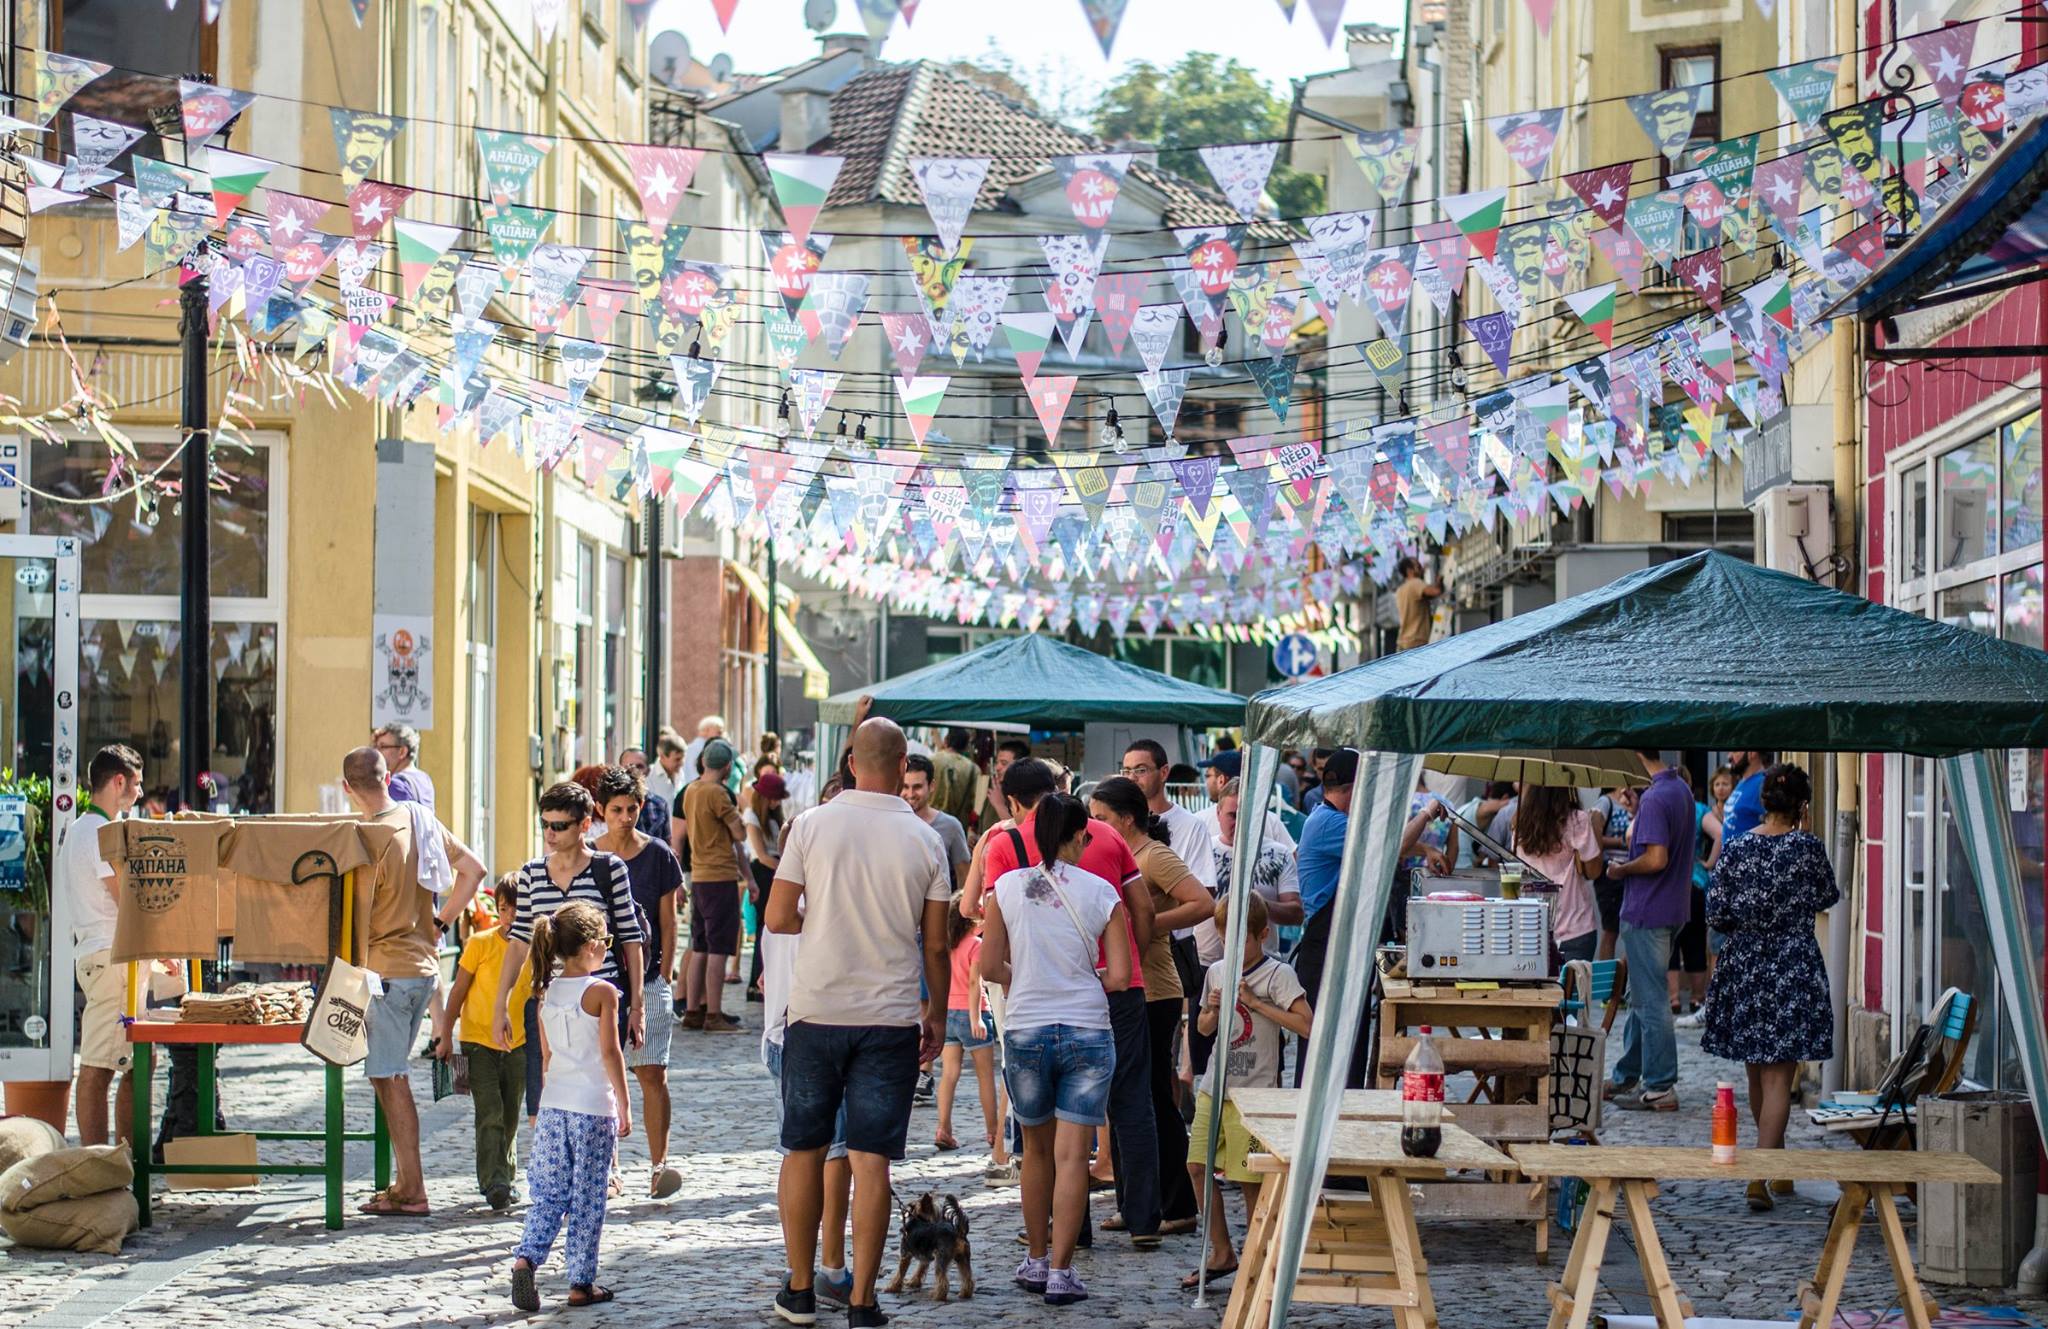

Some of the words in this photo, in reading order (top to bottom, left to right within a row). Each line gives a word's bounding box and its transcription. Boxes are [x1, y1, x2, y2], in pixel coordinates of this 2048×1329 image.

[1706, 156, 1752, 176] КАПАНА
[490, 223, 538, 240] КАПАНА
[350, 297, 382, 308] NEED
[1280, 446, 1311, 468] NEED
[129, 859, 186, 874] КАПАНА
